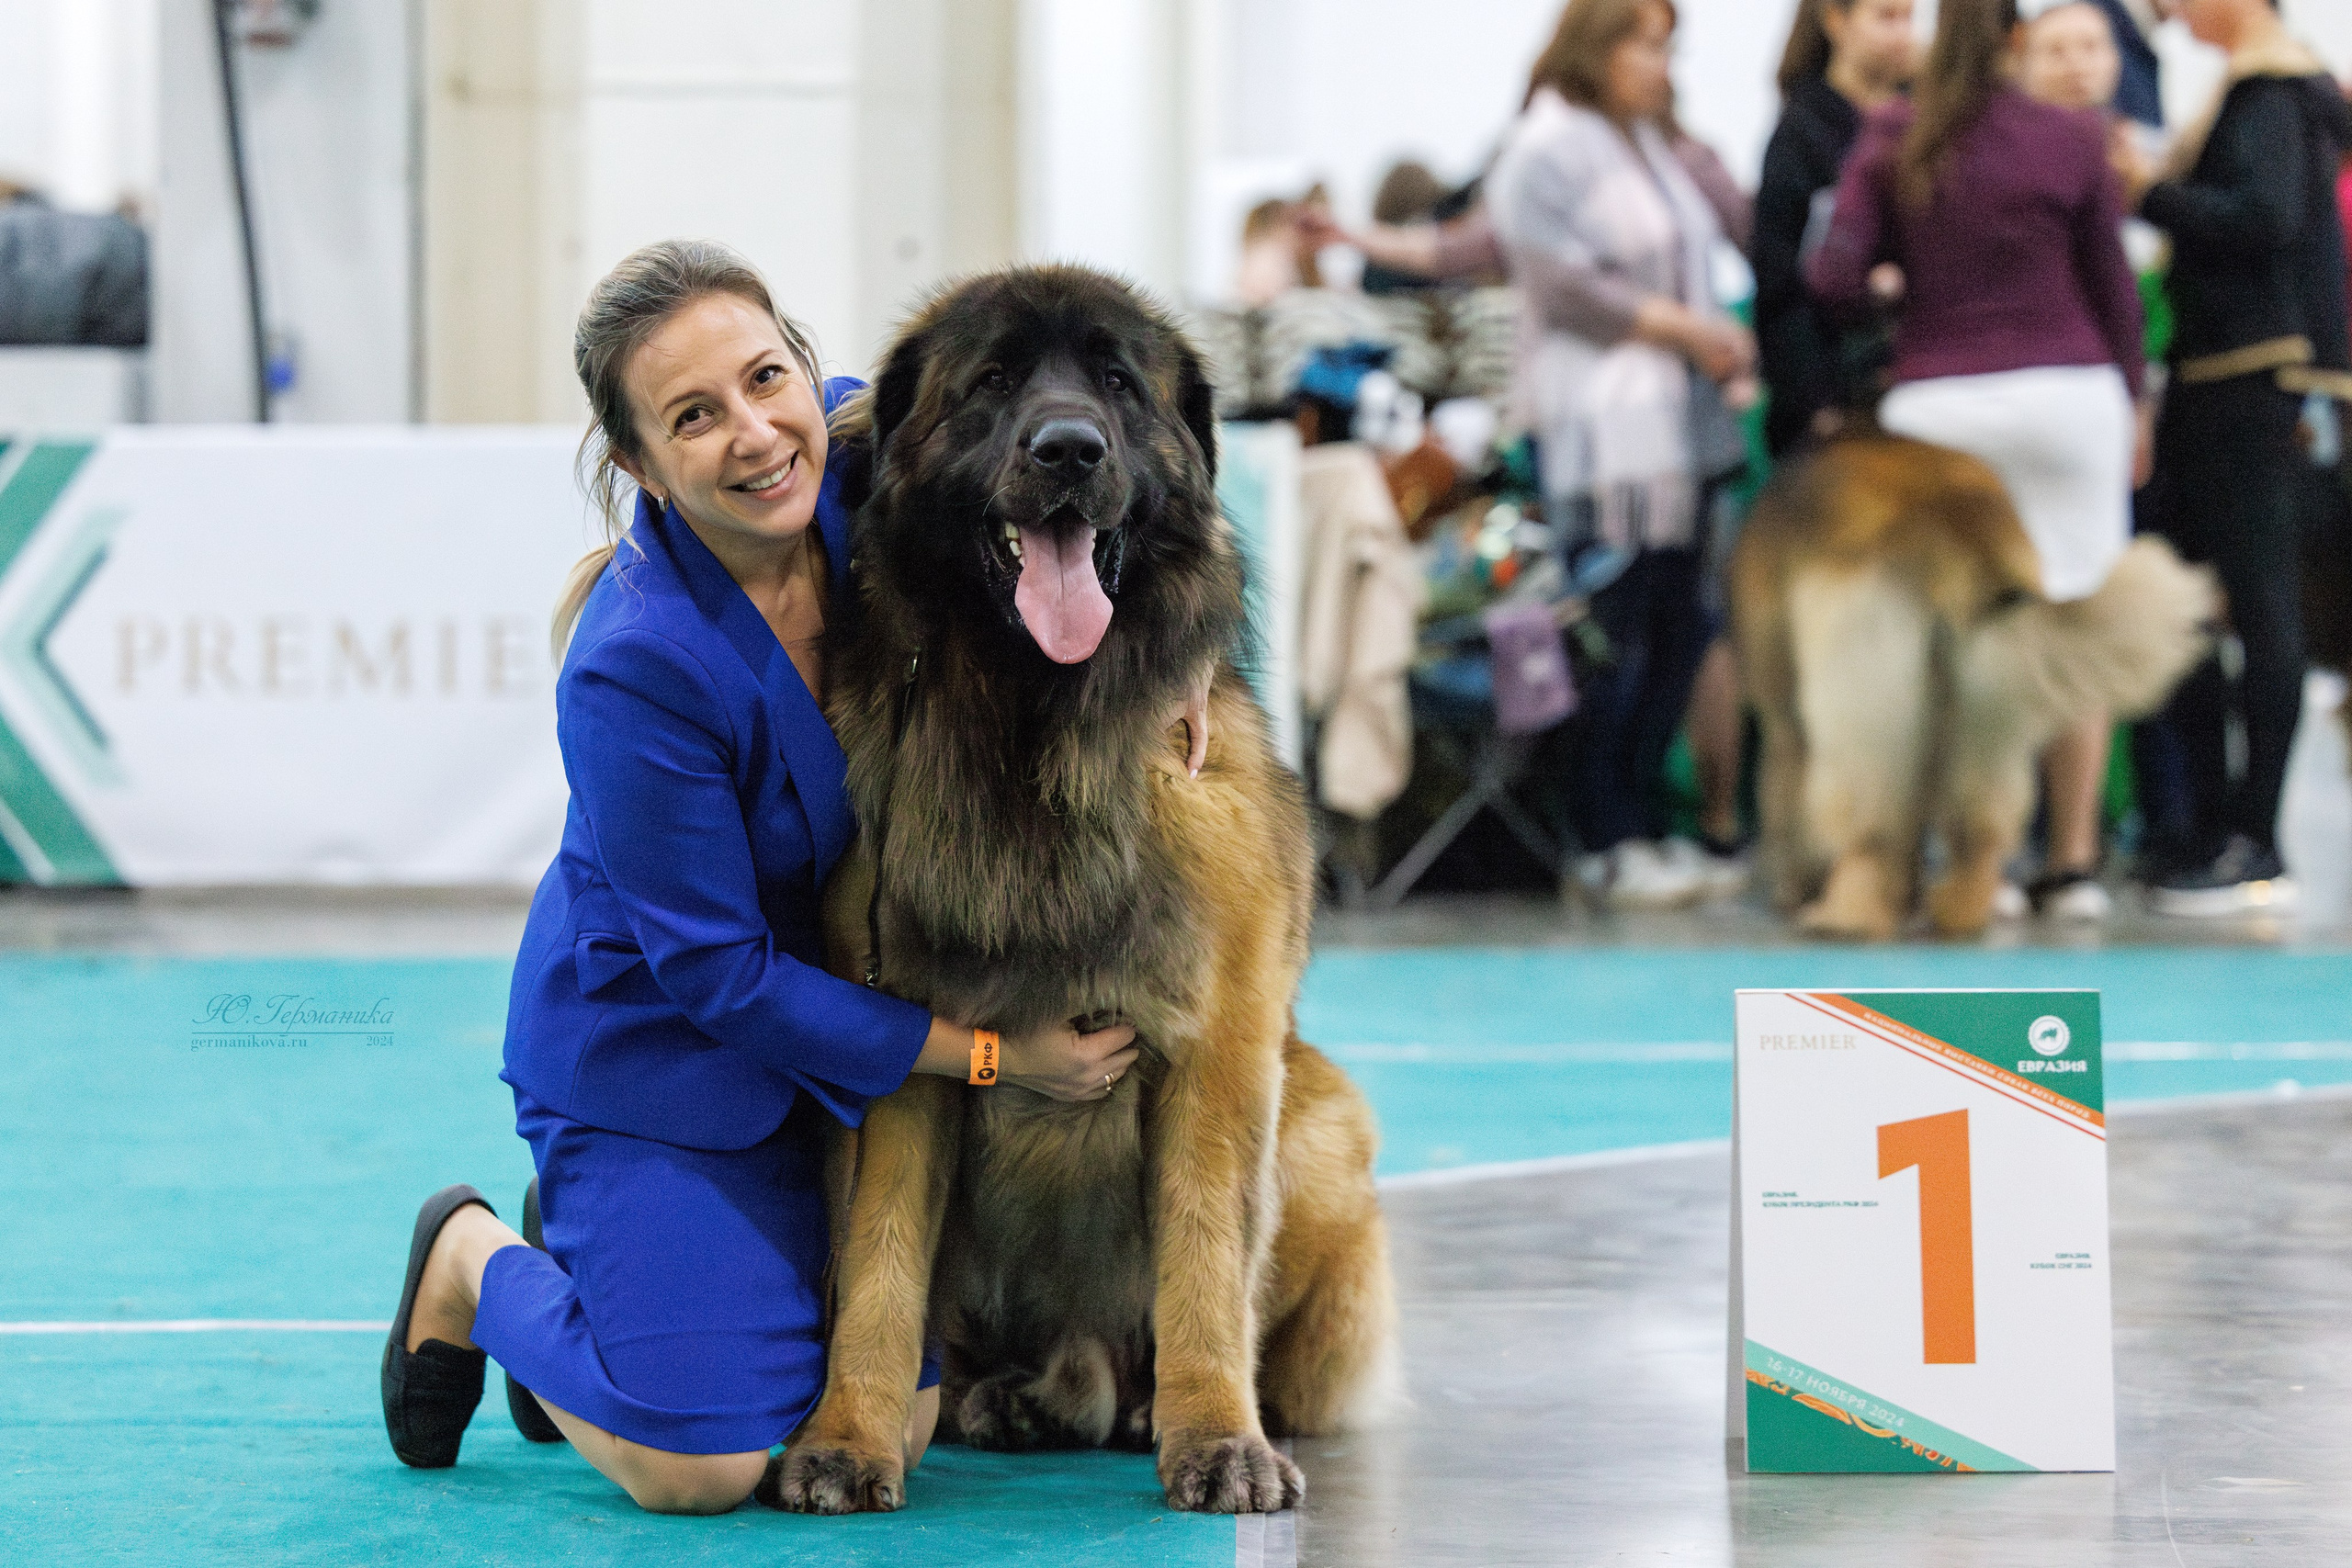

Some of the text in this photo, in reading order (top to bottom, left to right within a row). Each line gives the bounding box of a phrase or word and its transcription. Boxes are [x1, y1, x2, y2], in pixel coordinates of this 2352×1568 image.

[113, 614, 540, 699] PREMIE
[984, 1043, 993, 1065] РКФ
[1759, 1034, 1857, 1050] PREMIER
[2018, 1060, 2087, 1073] ЕВРАЗИЯ
[1877, 1109, 1976, 1364] 1
[1768, 1357, 1905, 1427] 16-17 НОЯБРЯ 2024
